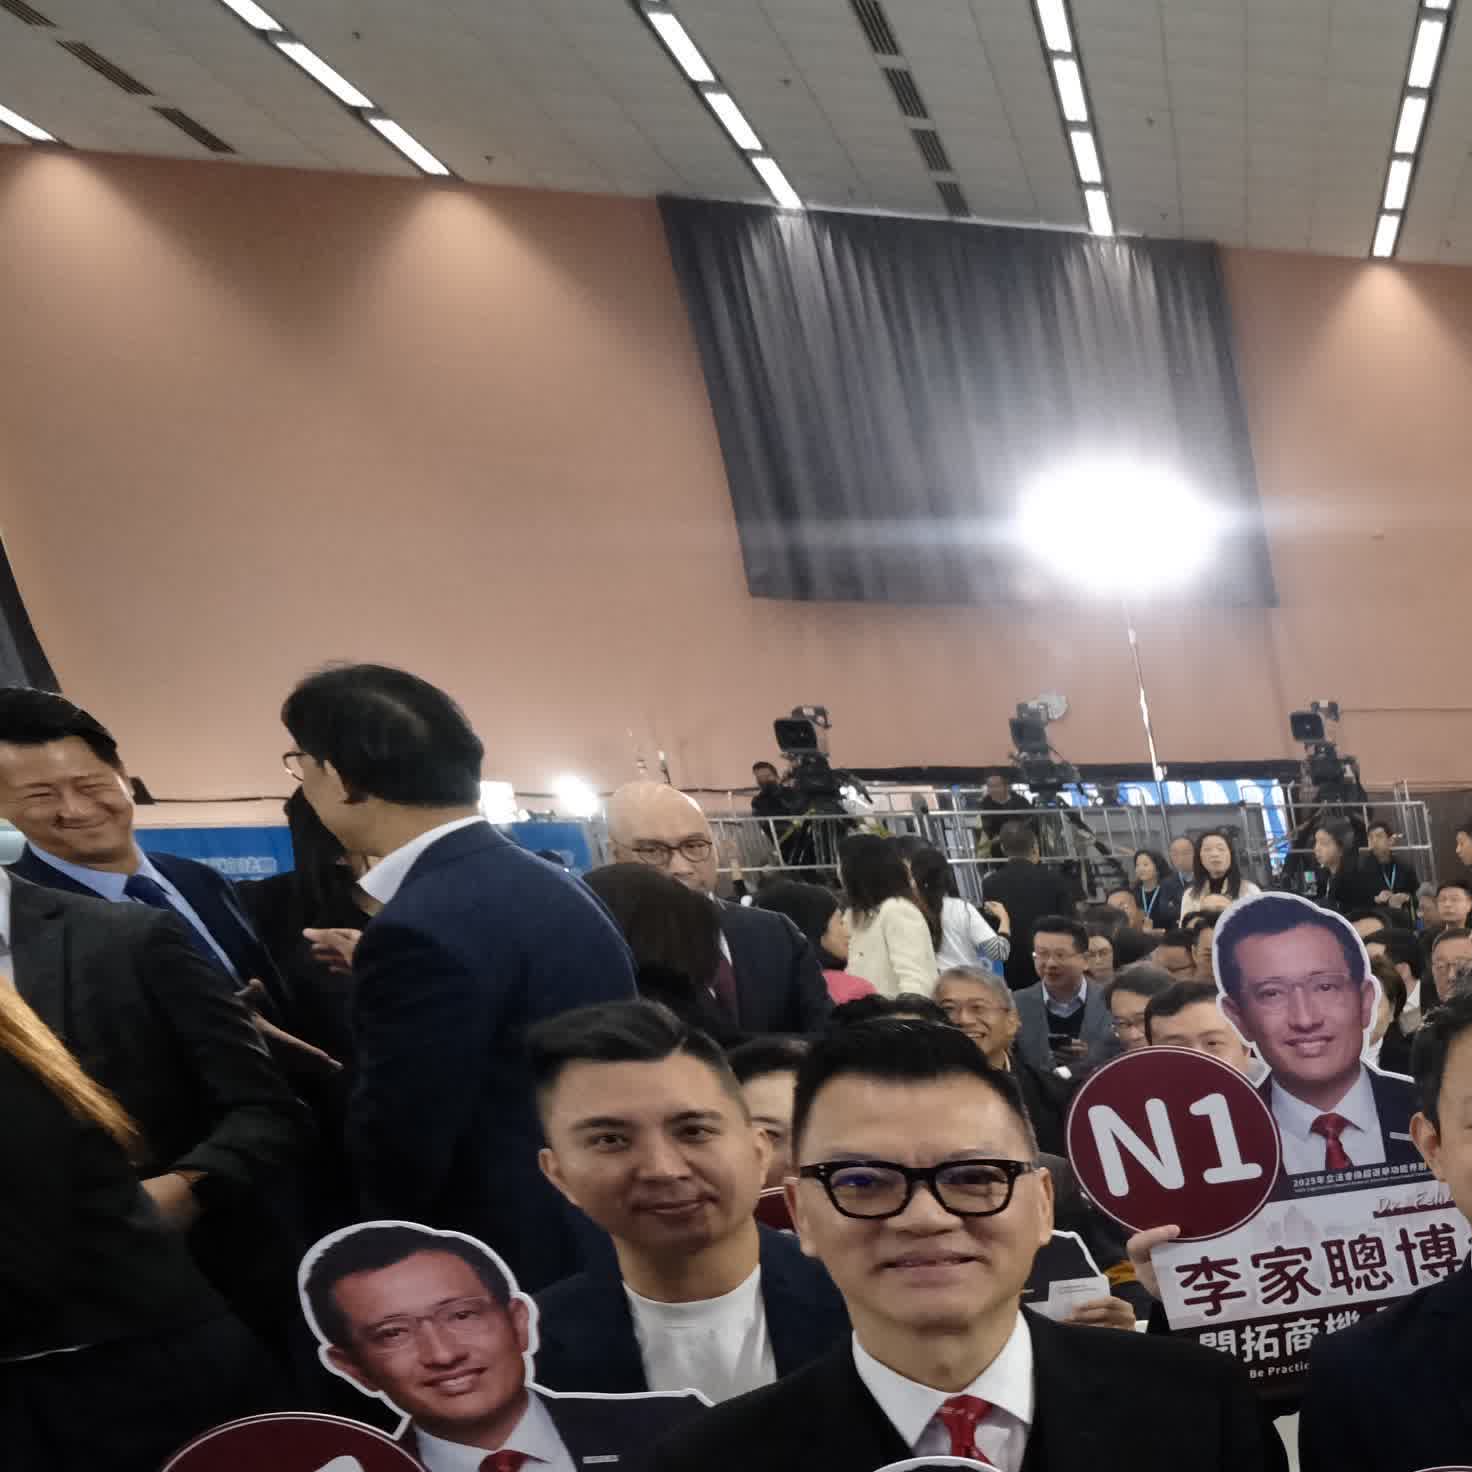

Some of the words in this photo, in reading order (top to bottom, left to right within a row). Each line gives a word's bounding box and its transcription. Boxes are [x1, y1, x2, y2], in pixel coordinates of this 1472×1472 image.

[1087, 1092, 1262, 1198] N1
[1175, 1223, 1472, 1317] 李家聰博
